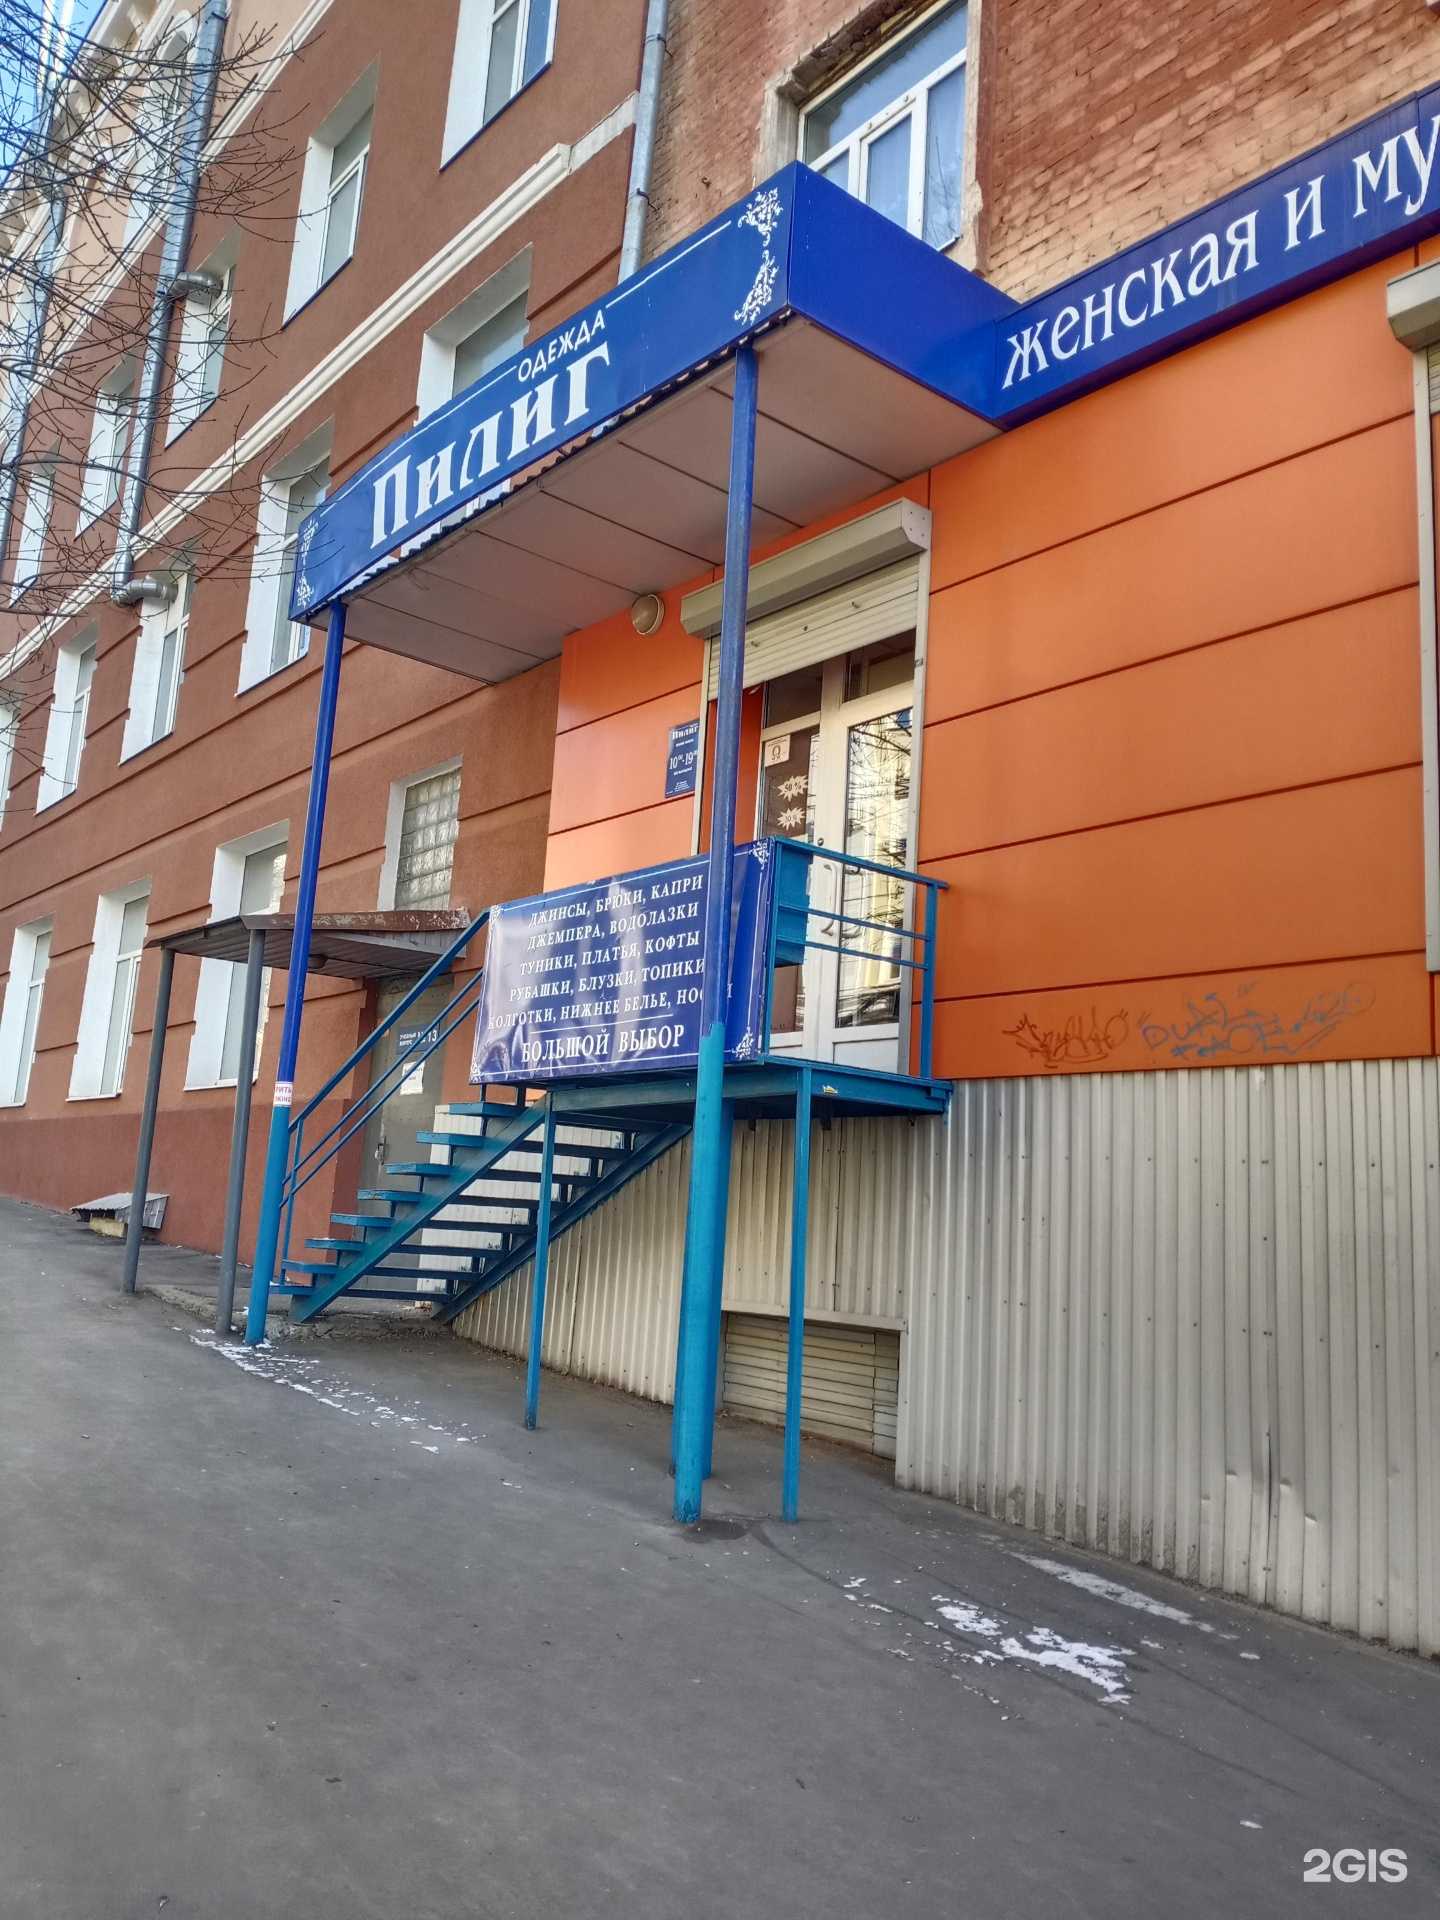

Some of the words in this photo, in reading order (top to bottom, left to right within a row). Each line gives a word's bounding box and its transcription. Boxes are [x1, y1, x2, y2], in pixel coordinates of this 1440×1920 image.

[1283, 174, 1326, 252] и
[518, 308, 606, 383] ОДЕЖДА
[528, 902, 591, 928] ДЖИНСЫ,
[596, 888, 646, 913] БРЮКИ,
[651, 874, 704, 900] КАПРИ
[527, 924, 605, 951] ДЖЕМПЕРА,
[610, 902, 699, 935] ВОДОЛАЗКИ
[520, 954, 577, 977] ТУНИКИ,
[581, 943, 641, 967] ПЛАТЬЯ,
[645, 930, 700, 955] КОФТЫ
[510, 980, 574, 1002] РУБАШКИ,
[578, 971, 637, 993] БЛУЗКИ,
[561, 999, 620, 1021] НИЖНЕЕ
[624, 991, 671, 1011] БЕЛЬЕ,
[521, 1029, 608, 1063] БОЛЬШОЙ
[619, 1024, 685, 1053] ВЫБОР
